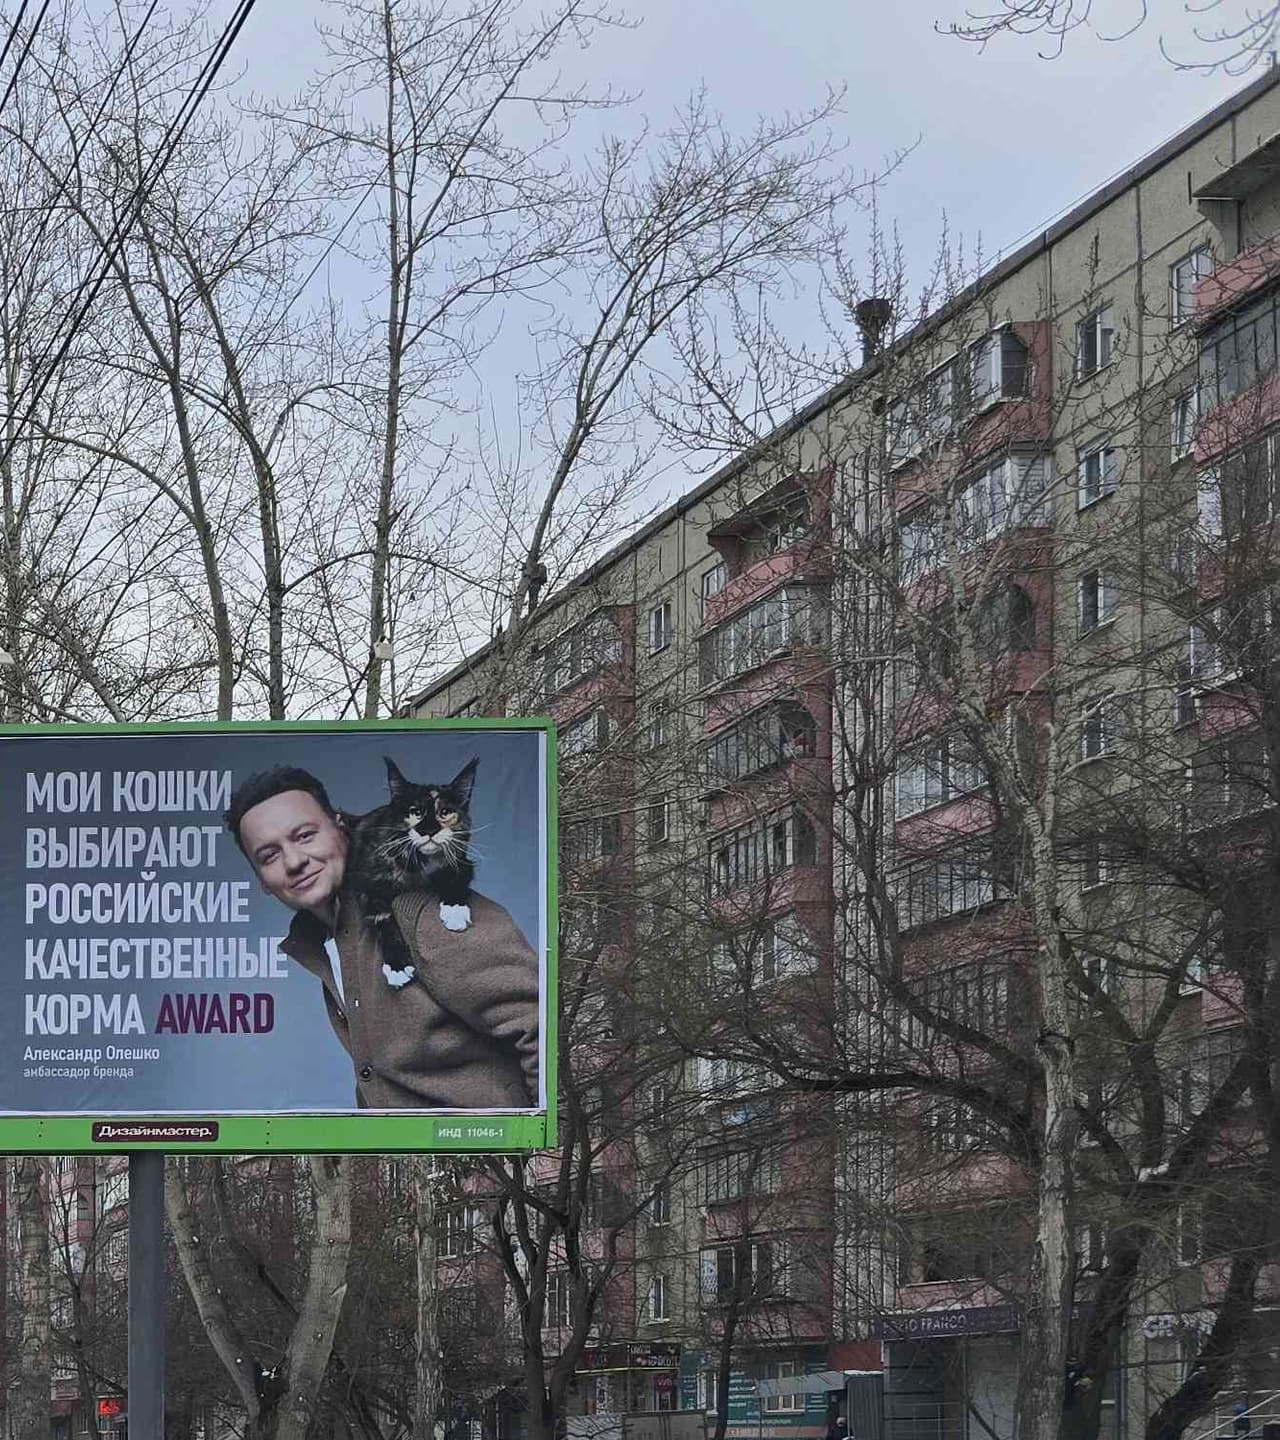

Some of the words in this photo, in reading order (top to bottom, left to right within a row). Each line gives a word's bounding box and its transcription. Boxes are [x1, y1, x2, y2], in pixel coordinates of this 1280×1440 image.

[26, 771, 101, 813] МОИ
[113, 770, 232, 812] КОШКИ
[26, 826, 222, 868] ВЫБИРАЮТ
[25, 871, 250, 924] РОССИЙСКИЕ
[24, 937, 289, 980] КАЧЕСТВЕННЫЕ
[24, 994, 146, 1035] КОРМА
[154, 993, 275, 1034] AWARD
[24, 1046, 102, 1063] Александр
[106, 1046, 160, 1060] Олешко
[93, 1066, 134, 1079] бренда
